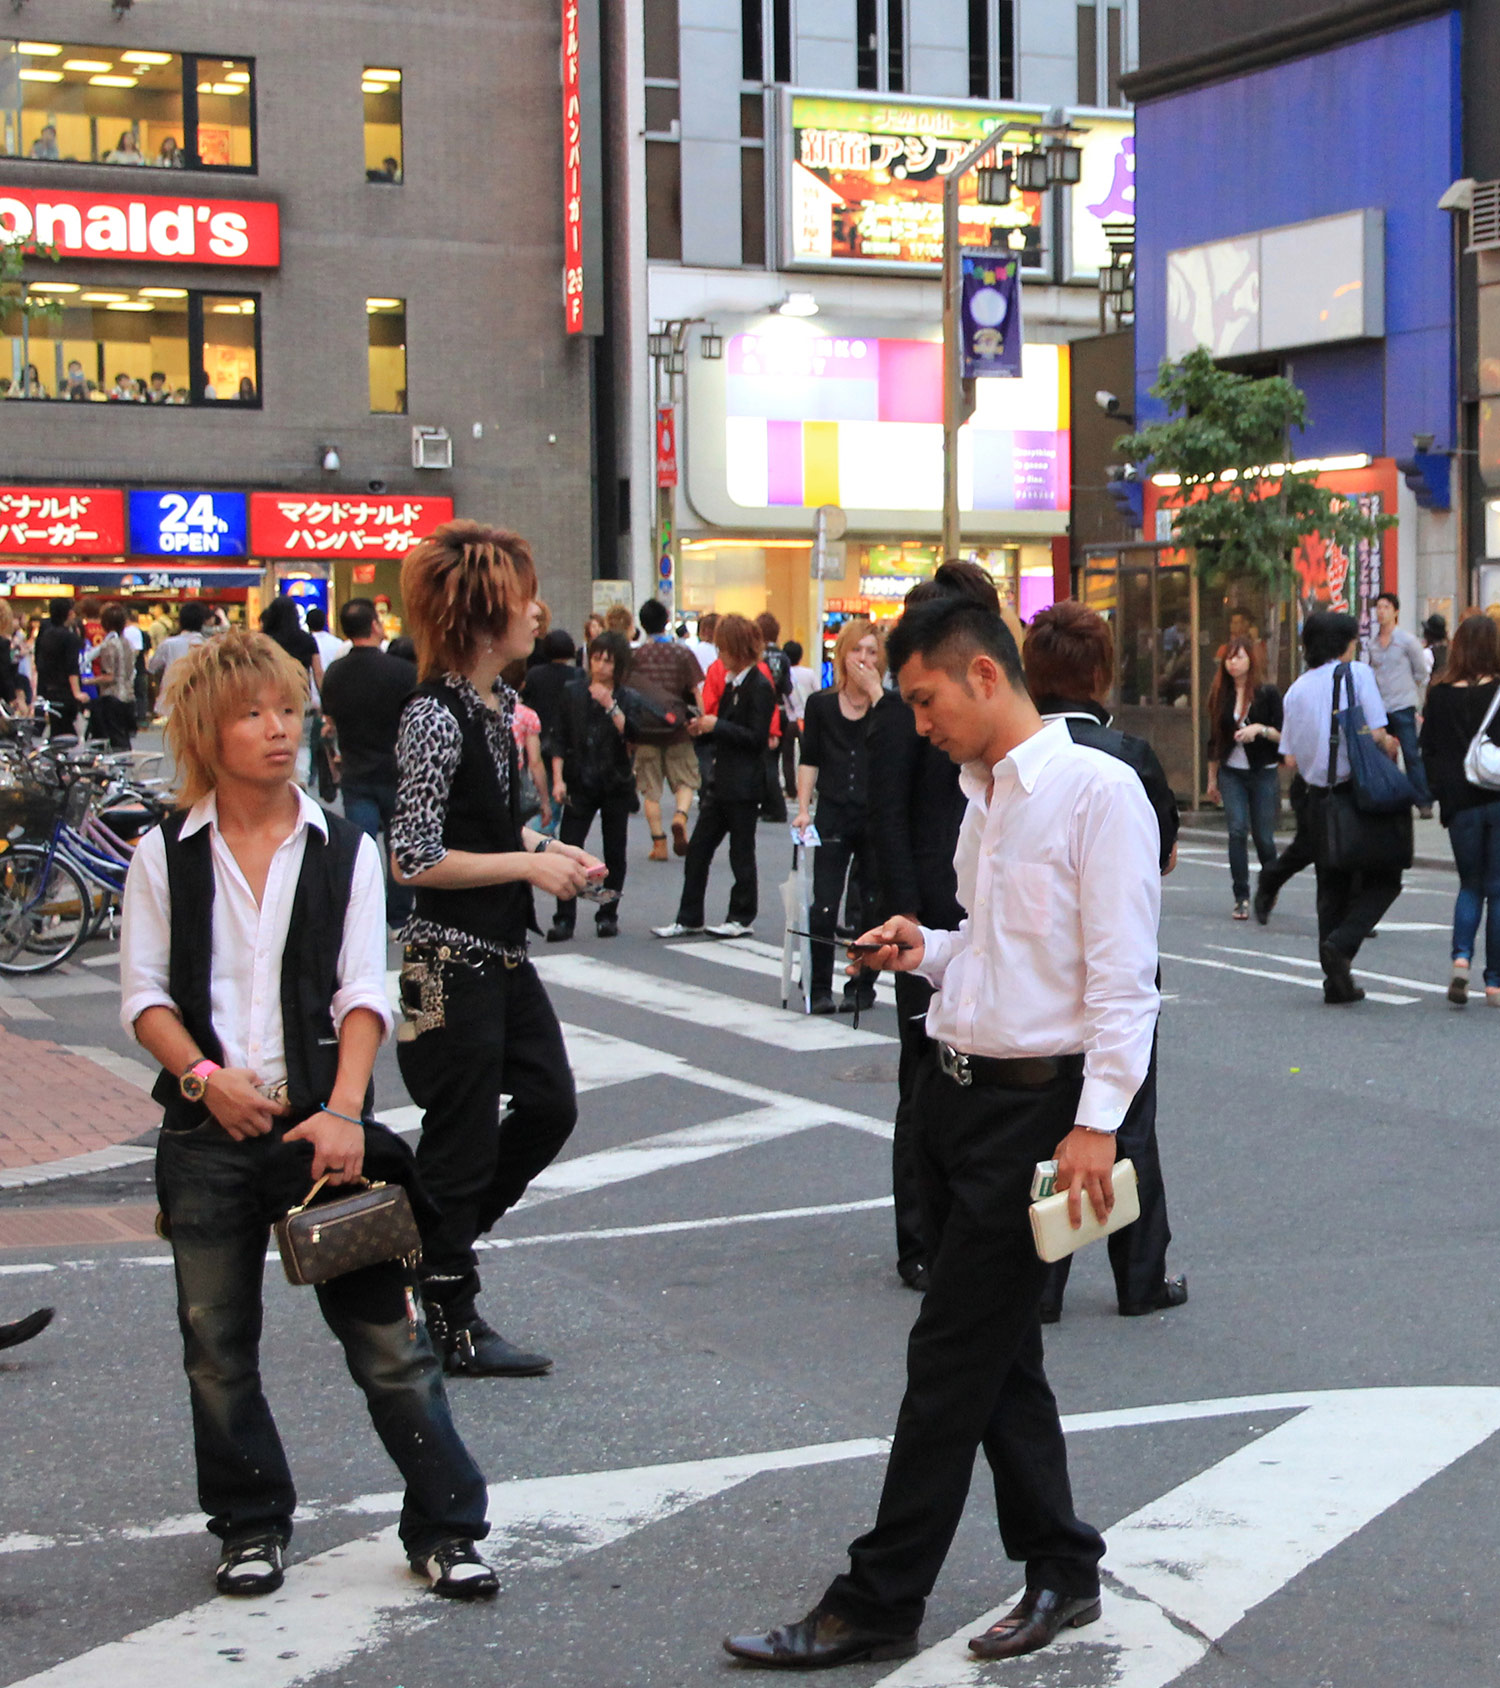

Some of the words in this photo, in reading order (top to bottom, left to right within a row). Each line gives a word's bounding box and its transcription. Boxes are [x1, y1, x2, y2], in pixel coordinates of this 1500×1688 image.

[566, 0, 579, 84] ナルド
[277, 501, 423, 527] マクドナルド
[159, 532, 219, 552] OPEN
[284, 528, 430, 552] ハンバーガー
